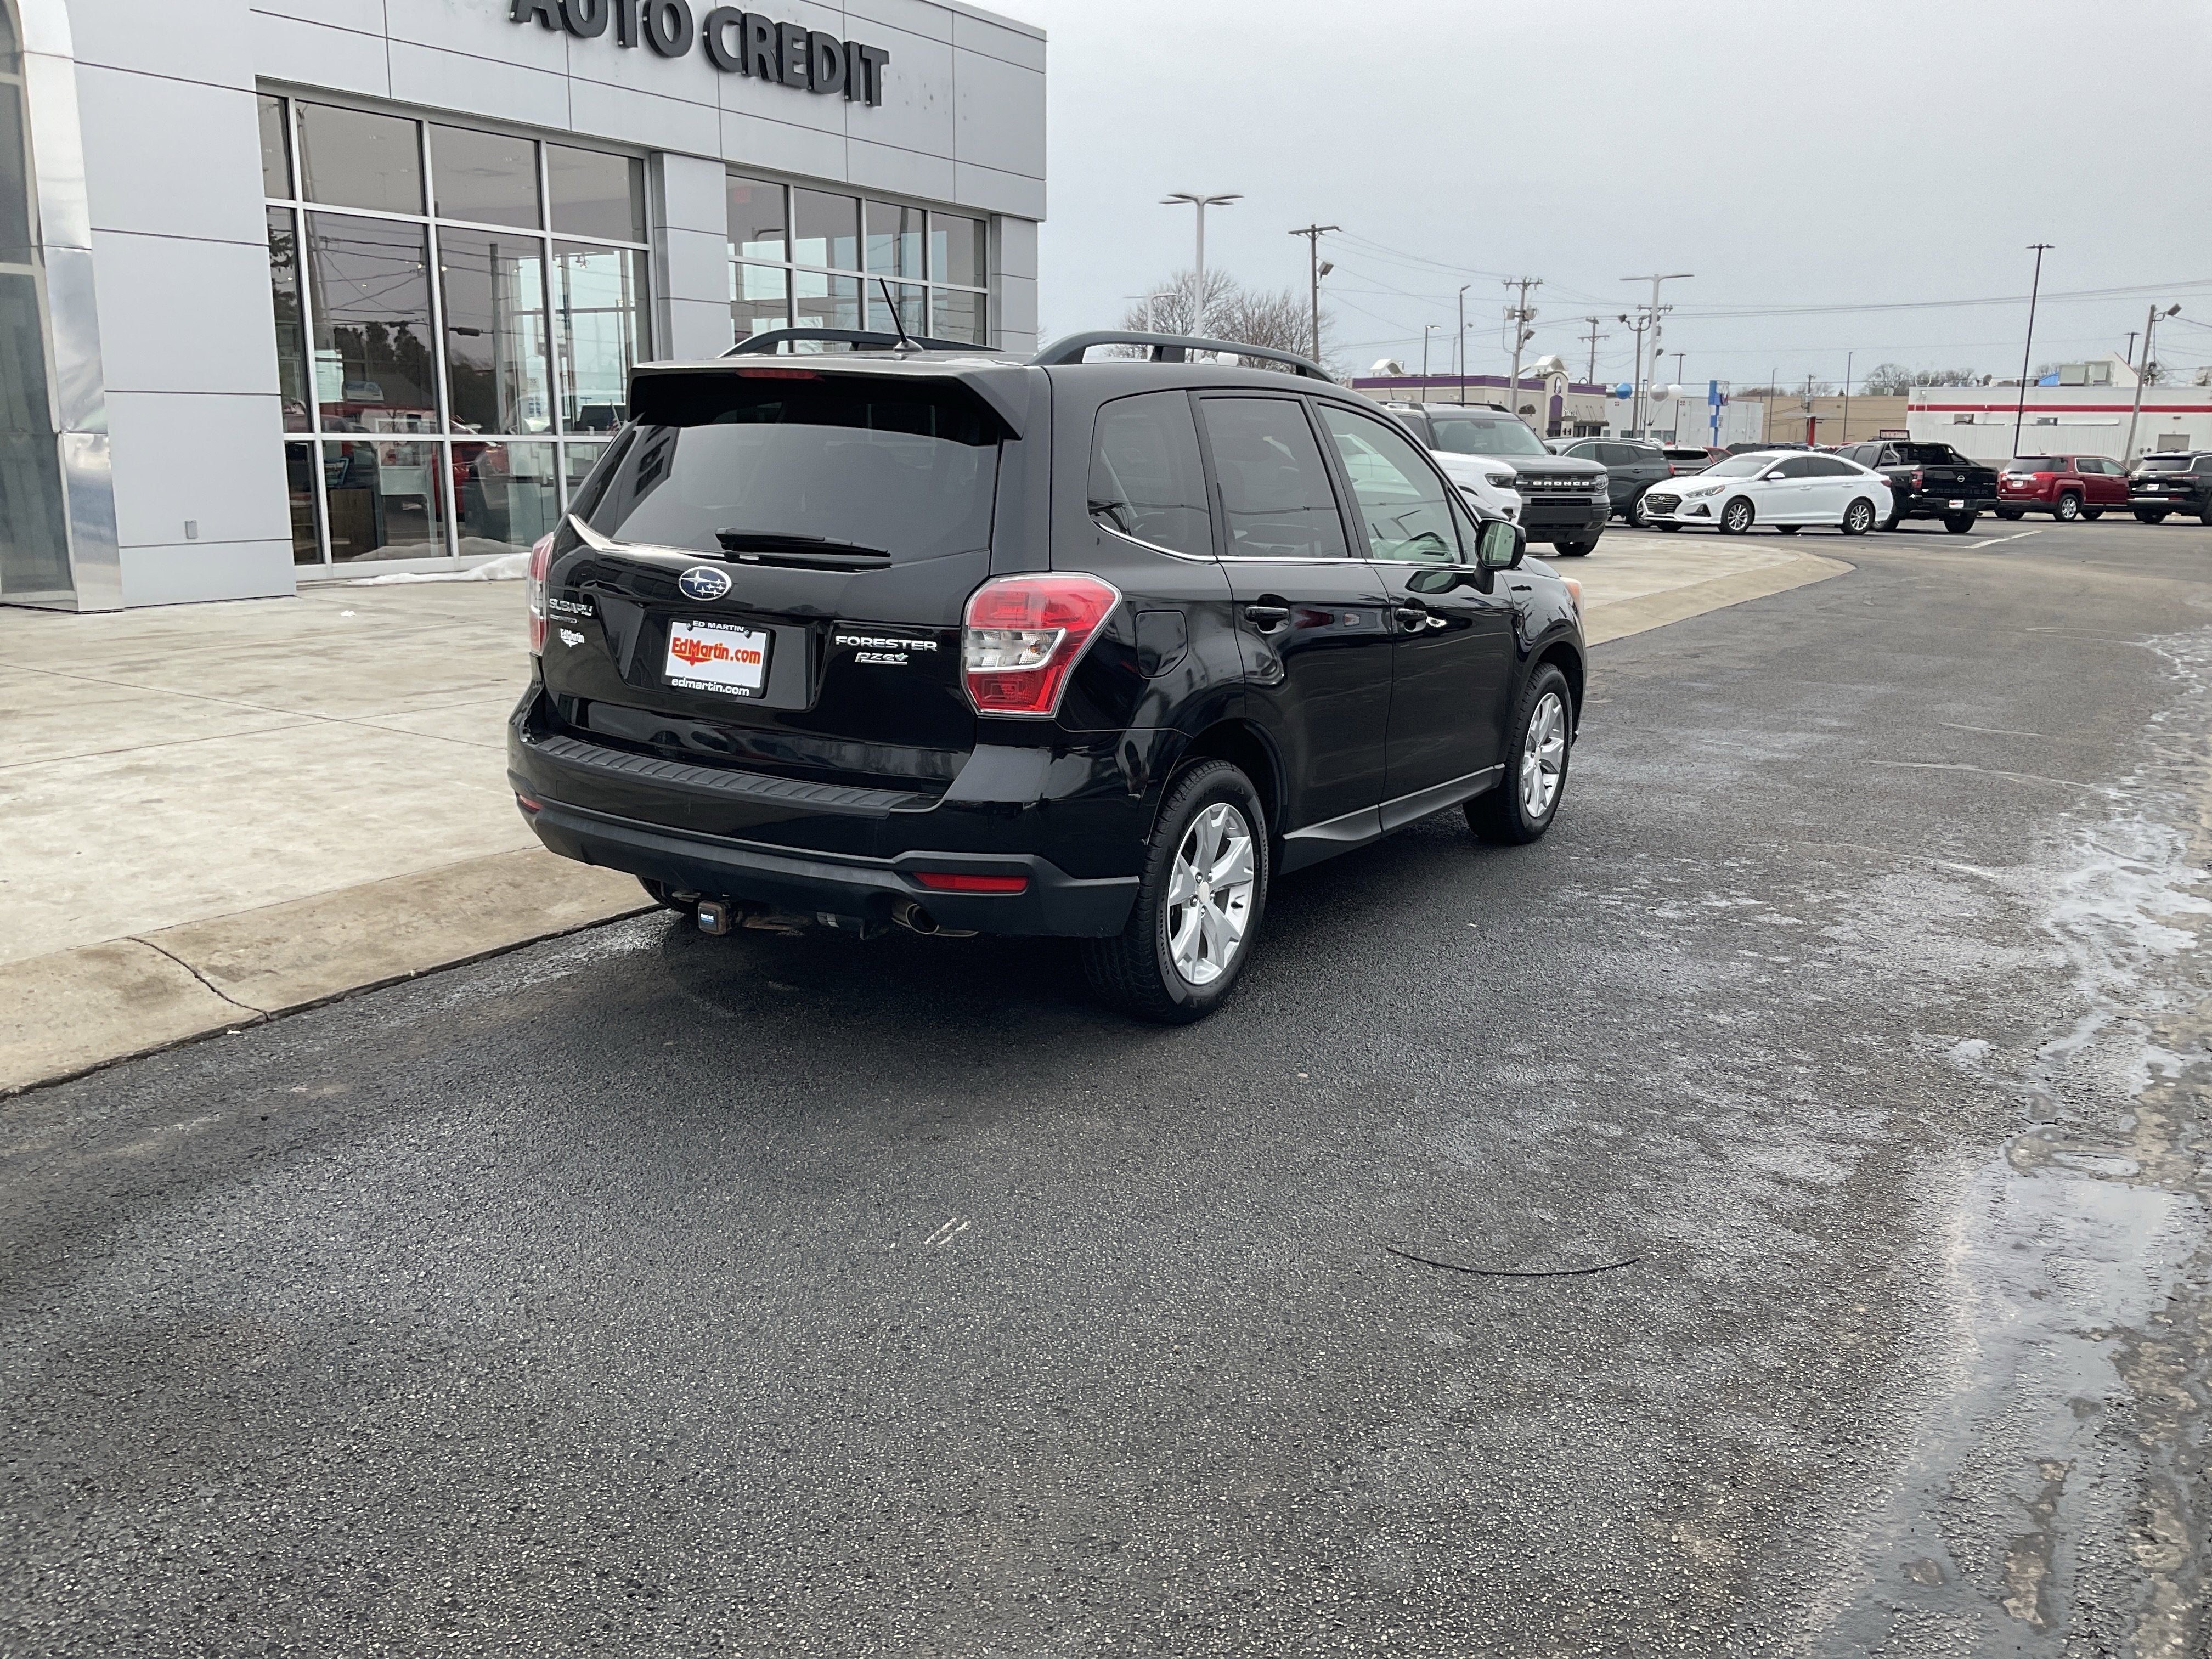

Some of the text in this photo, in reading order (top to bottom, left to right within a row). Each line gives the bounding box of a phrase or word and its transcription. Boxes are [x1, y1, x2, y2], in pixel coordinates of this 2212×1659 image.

[703, 6, 889, 107] CREDIT
[549, 598, 592, 616] SUBARU
[708, 622, 744, 632] MARTIN
[836, 635, 938, 652] FORESTER
[672, 678, 750, 696] edmartin.com
